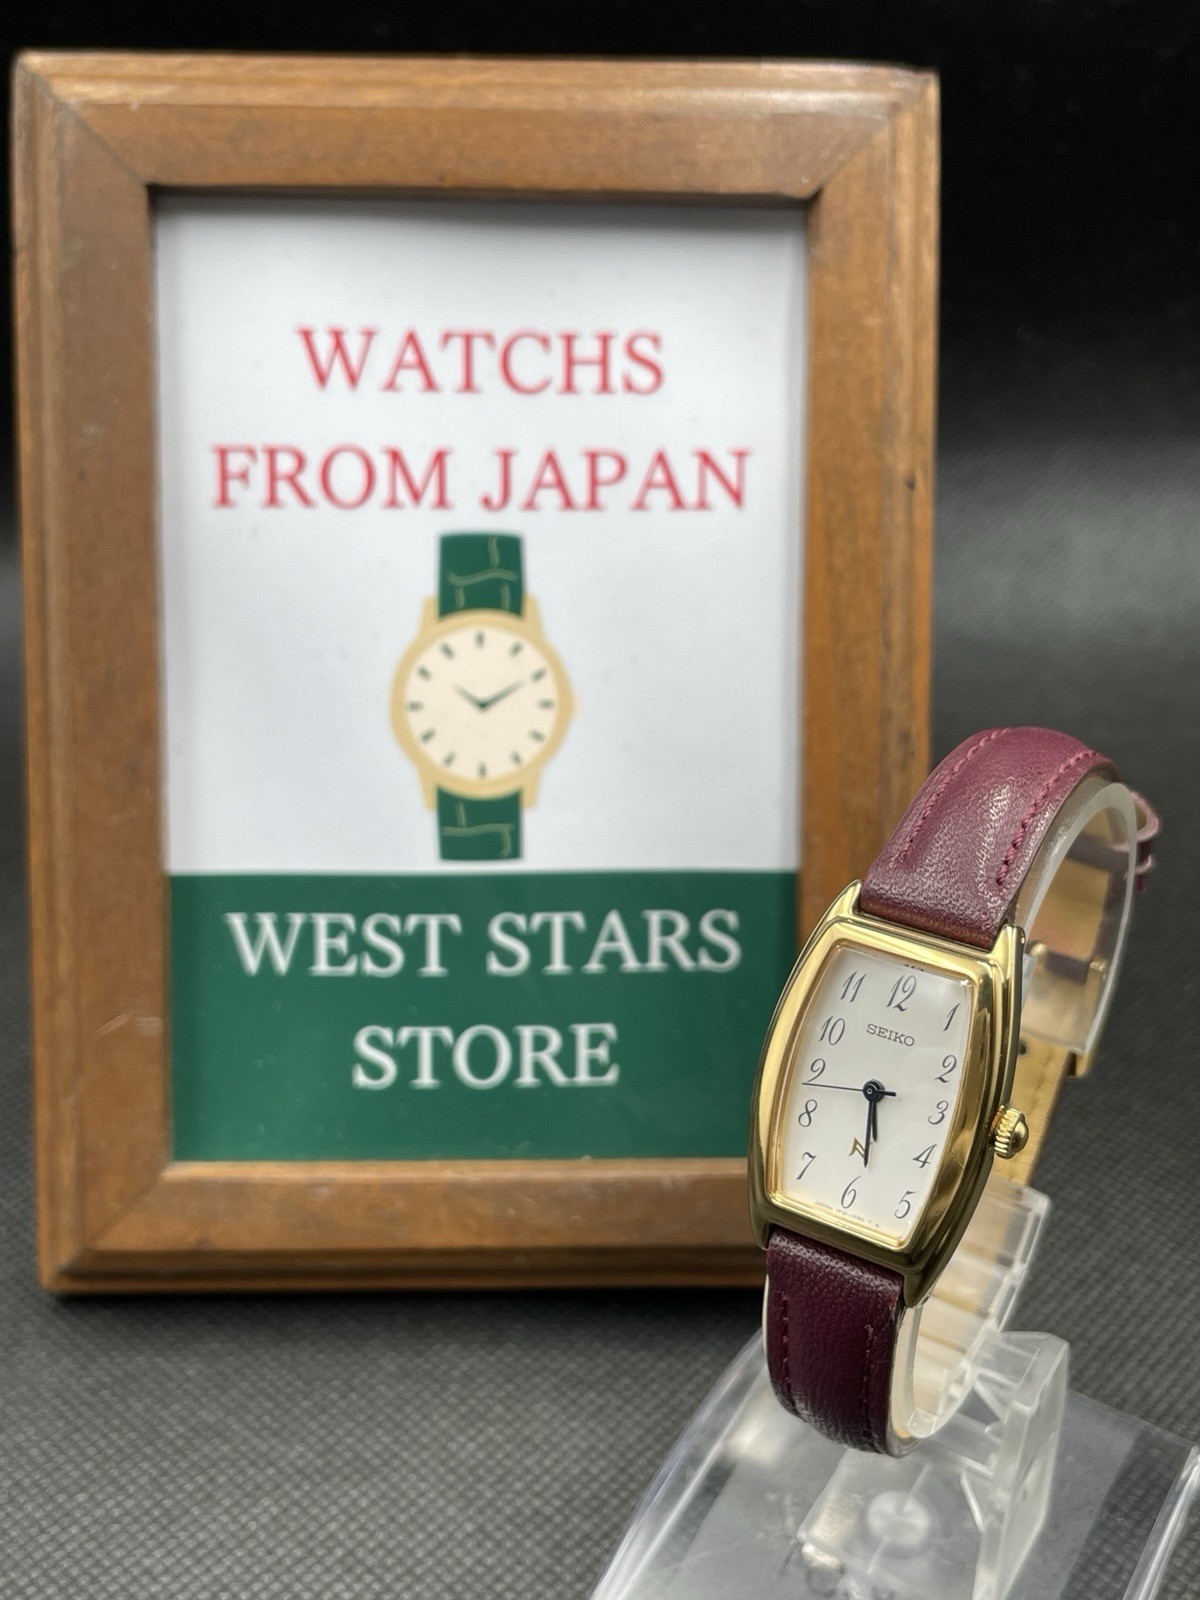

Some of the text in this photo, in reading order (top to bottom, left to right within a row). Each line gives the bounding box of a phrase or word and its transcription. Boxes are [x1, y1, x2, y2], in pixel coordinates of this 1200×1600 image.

[298, 327, 663, 394] WATCHS
[213, 444, 749, 510] FROM JAPAN
[226, 909, 741, 978] WEST STARS
[840, 971, 866, 1003] 11
[886, 975, 917, 1012] 12
[818, 1017, 846, 1046] 10
[943, 1002, 961, 1031] 1
[866, 1023, 915, 1047] SEIKO
[352, 1022, 620, 1090] STORE
[807, 1058, 826, 1083] 9
[934, 1054, 957, 1083] 2
[798, 1099, 818, 1127] 8
[928, 1100, 949, 1125] 3
[796, 1151, 817, 1181] 7
[912, 1144, 938, 1169] 4
[840, 1175, 862, 1209] 6
[894, 1190, 917, 1220] 5
